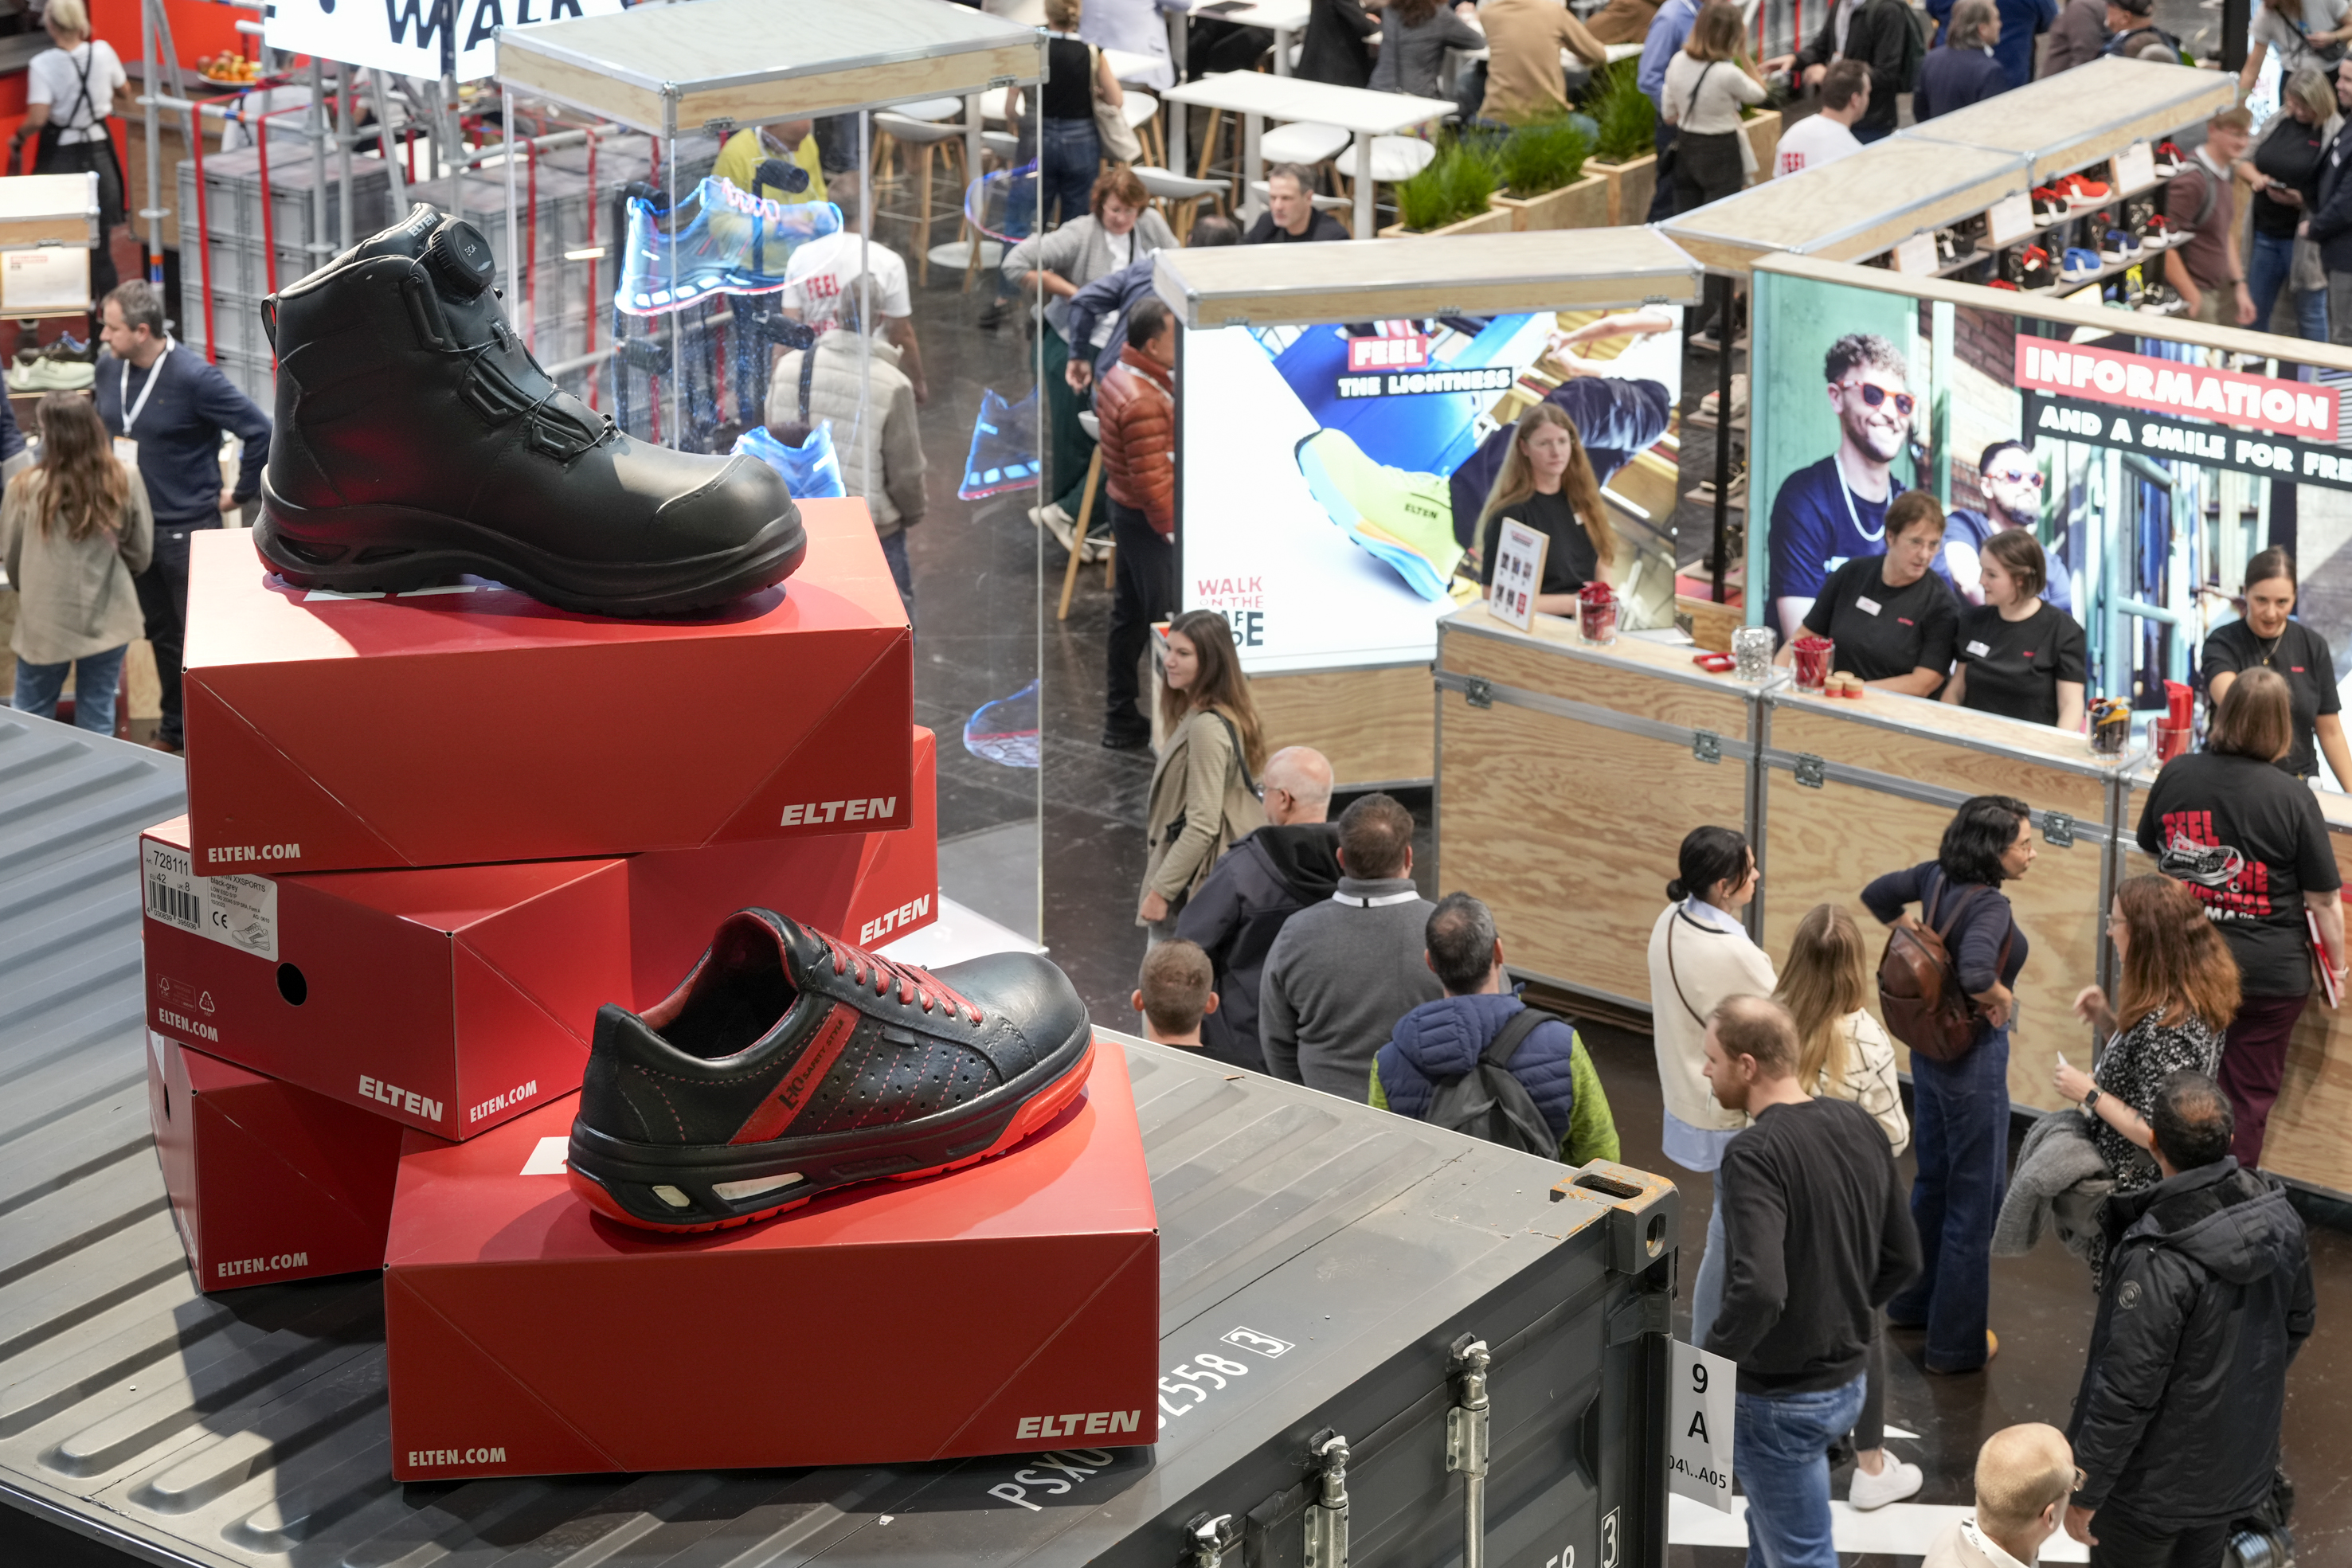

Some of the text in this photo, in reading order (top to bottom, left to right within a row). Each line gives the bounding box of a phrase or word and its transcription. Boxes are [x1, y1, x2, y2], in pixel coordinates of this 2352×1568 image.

[407, 212, 438, 237] ELTEN
[1354, 338, 1423, 366] FEEL
[1338, 369, 1511, 397] THE LIGHTNESS
[2025, 346, 2330, 431] INFORMATION
[2038, 405, 2103, 436] AND
[2110, 418, 2134, 444] A
[2142, 423, 2227, 460] SMILE
[2236, 439, 2294, 473] FOR
[1198, 576, 1262, 596] WALK
[1199, 596, 1263, 608] ON THE
[781, 796, 897, 827] ELTEN
[2162, 811, 2220, 850] FEEL
[154, 850, 188, 876] 728111
[208, 843, 301, 862] ELTEN.COM
[157, 873, 166, 884] 42
[185, 882, 190, 892] 8
[210, 877, 238, 893] black-grey
[233, 875, 266, 892] XXSPORTS
[859, 893, 930, 946] ELTEN
[159, 1007, 219, 1042] ELTEN.COM
[802, 1046, 826, 1080] SAFETY
[826, 1019, 844, 1046] STYLE
[358, 1074, 444, 1122] ELTEN
[470, 1080, 538, 1124] ELTEN.COM
[217, 1252, 308, 1277] ELTEN.COM
[1158, 1331, 1285, 1429] 2558 3
[1692, 1363, 1708, 1394] 9
[1016, 1410, 1141, 1439] ELTEN
[1687, 1410, 1709, 1445] A
[409, 1447, 507, 1467] ELTEN.COM
[1603, 1515, 1617, 1568] 3
